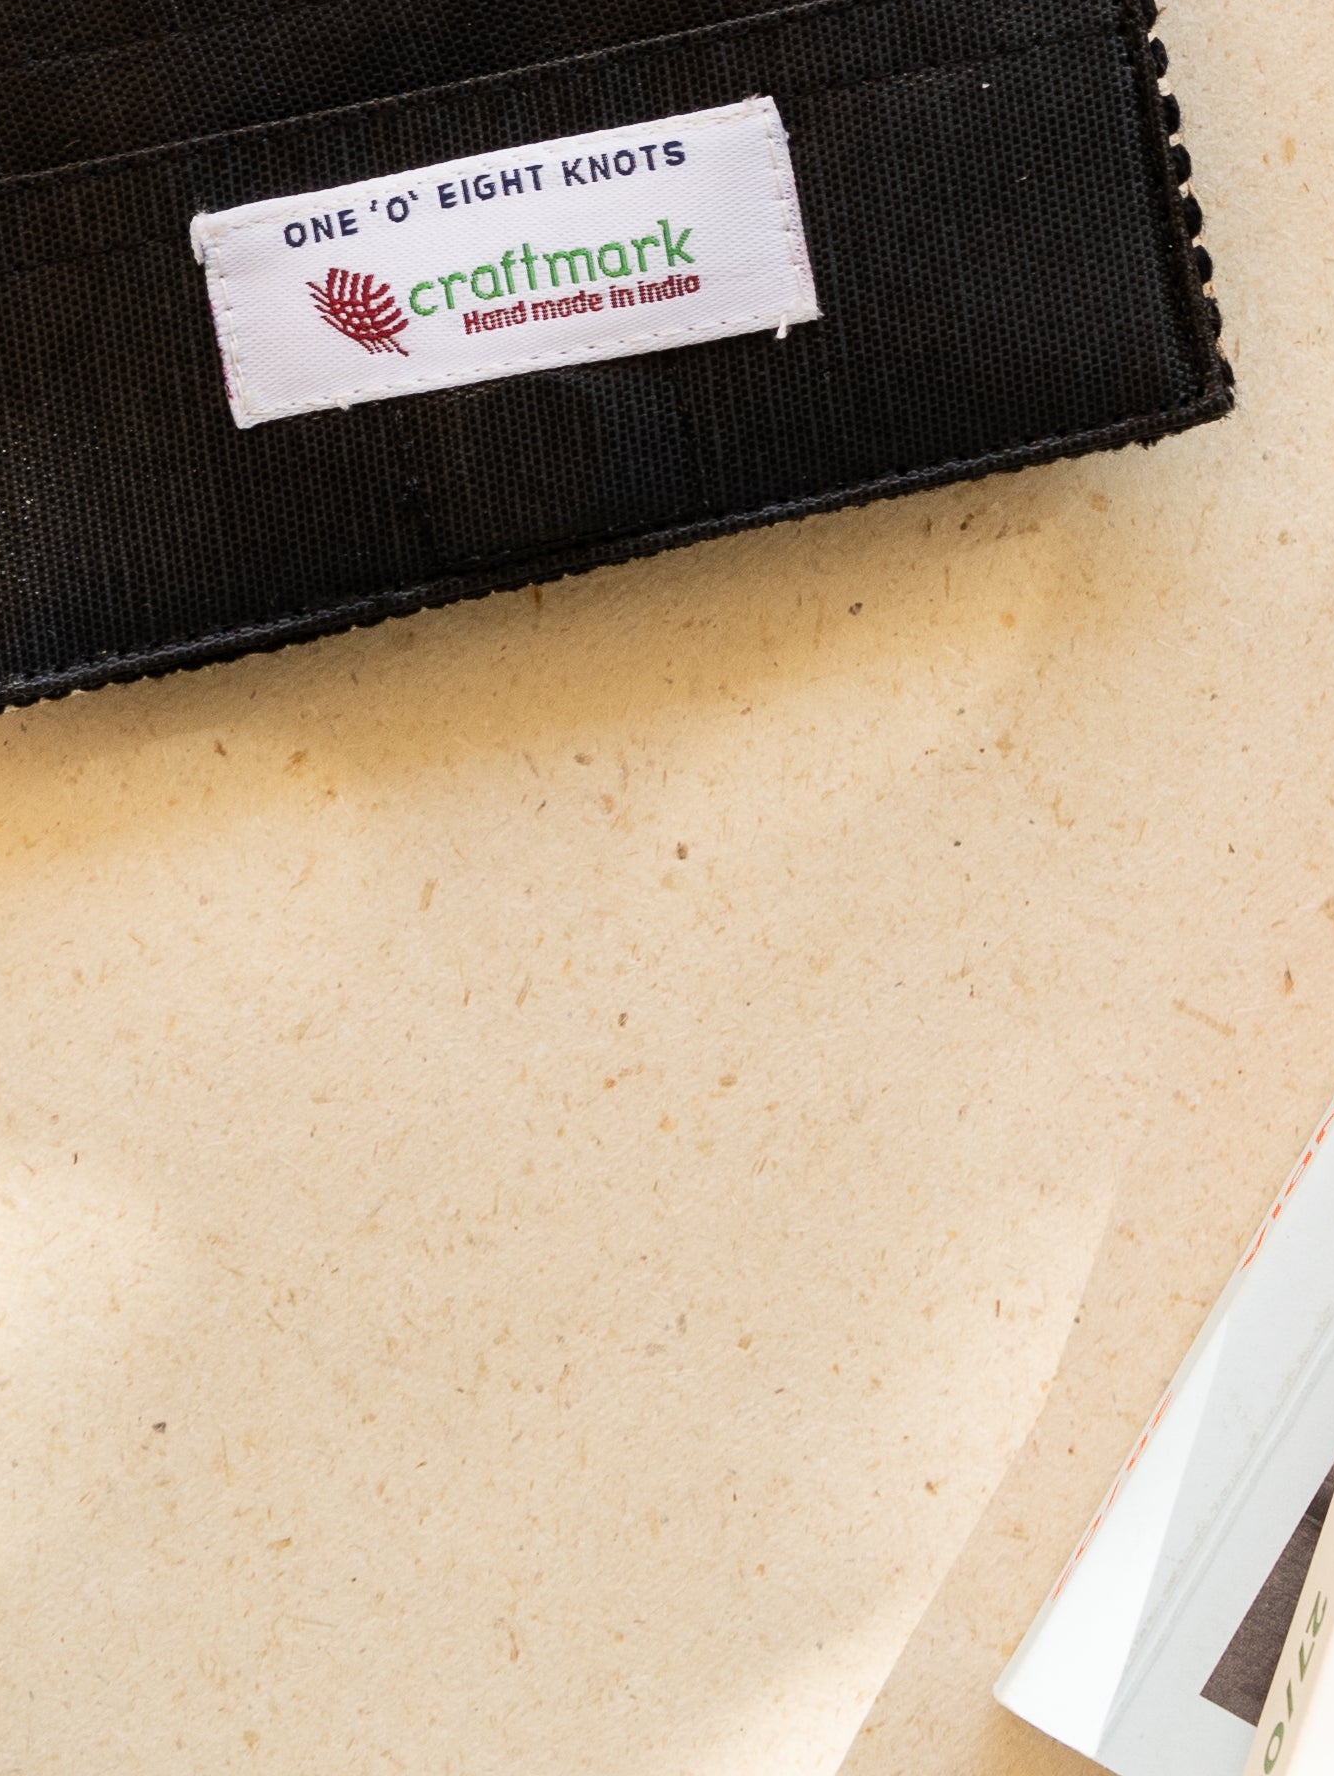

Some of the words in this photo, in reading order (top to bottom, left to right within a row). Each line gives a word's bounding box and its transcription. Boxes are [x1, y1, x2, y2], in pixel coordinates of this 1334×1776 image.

[283, 208, 359, 248] ONE
[437, 164, 544, 210] EIGHT
[561, 140, 686, 187] KNOTS
[409, 219, 695, 317] craftmark
[462, 300, 528, 335] Hand
[531, 289, 604, 321] made
[609, 285, 635, 308] in
